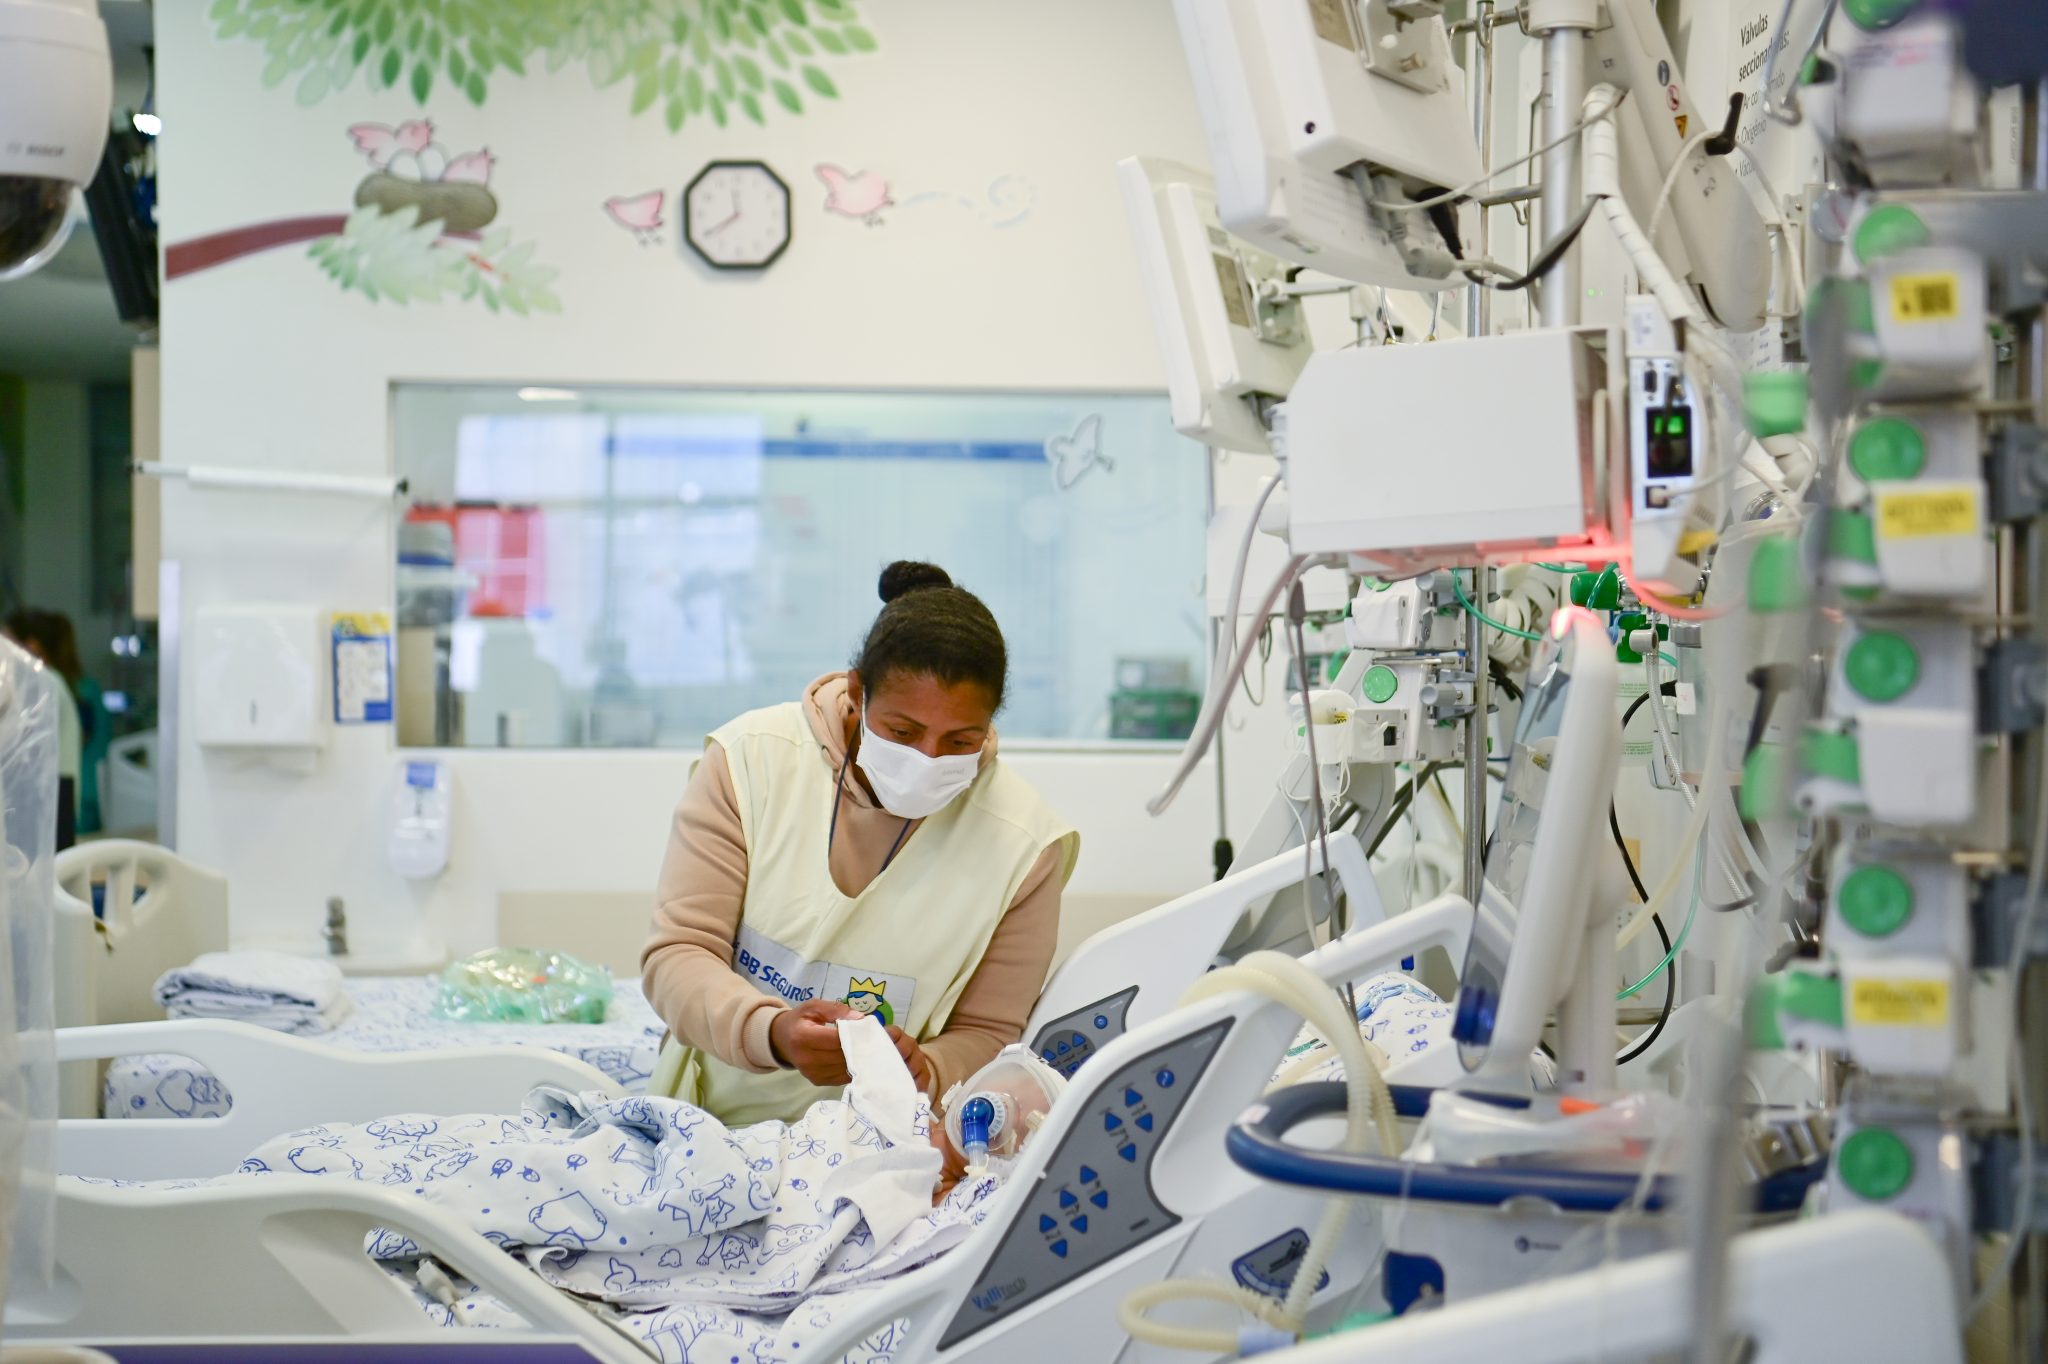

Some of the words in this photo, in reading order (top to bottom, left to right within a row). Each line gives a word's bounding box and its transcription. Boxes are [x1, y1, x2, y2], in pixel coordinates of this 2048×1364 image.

[1740, 13, 1768, 48] Válvulas
[739, 948, 761, 975] BB
[758, 965, 814, 1002] SEGUROS
